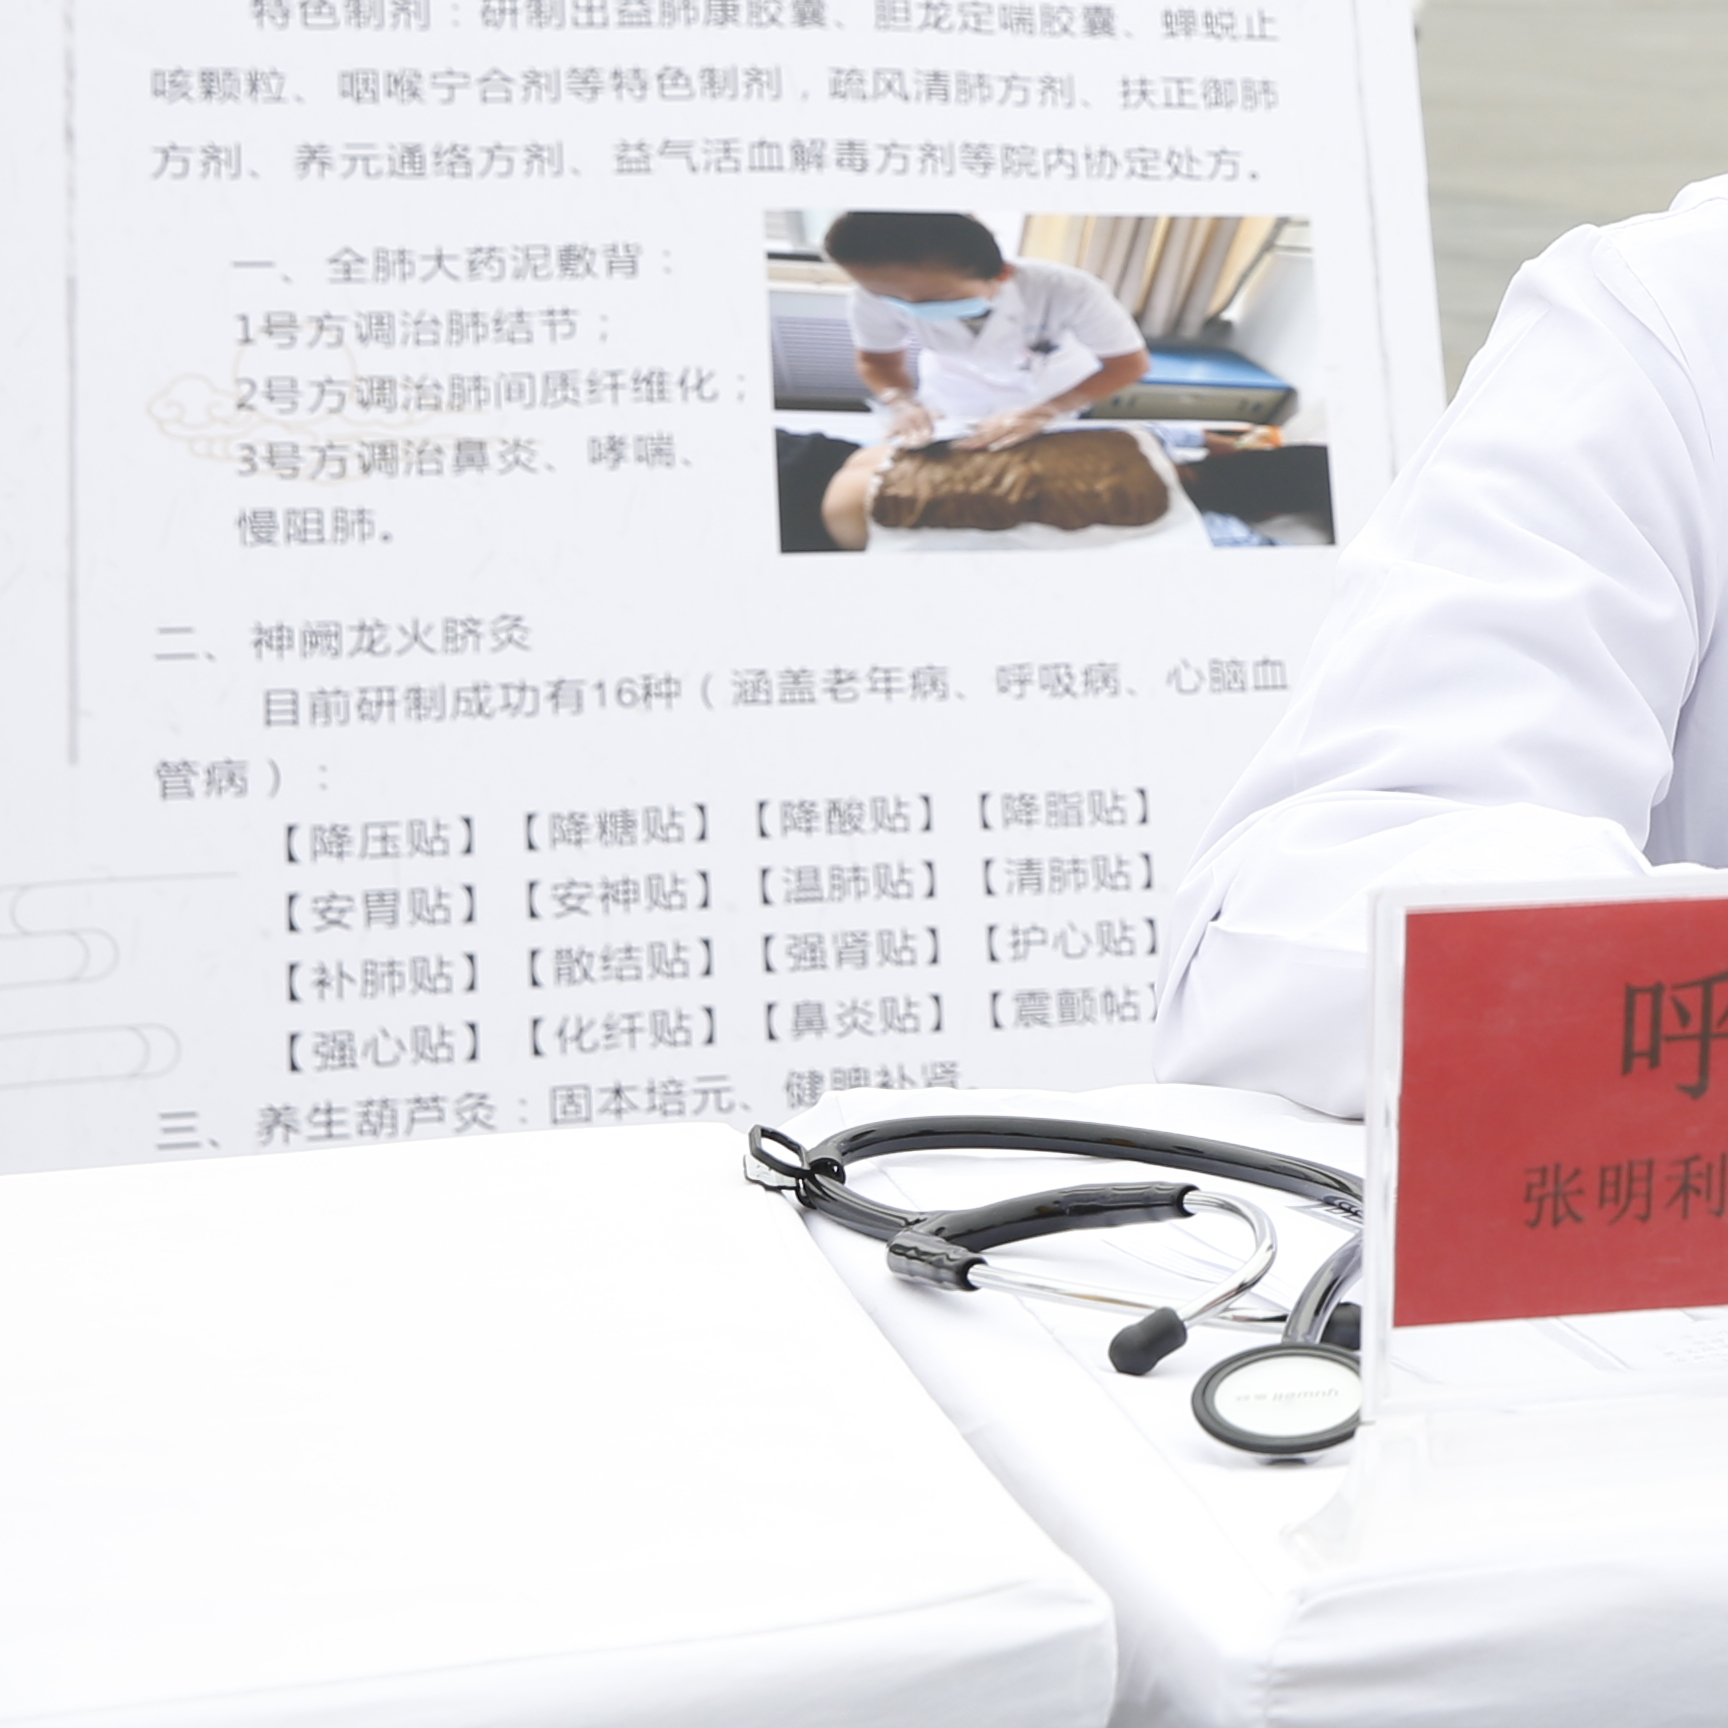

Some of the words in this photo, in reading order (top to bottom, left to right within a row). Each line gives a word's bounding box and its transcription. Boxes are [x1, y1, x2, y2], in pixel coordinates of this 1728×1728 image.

[235, 507, 393, 548] 慢阻肺。
[284, 815, 476, 865] 【降压贴】
[524, 803, 709, 853] 【降糖贴】
[755, 794, 933, 840] 【降酸贴】
[978, 787, 1150, 831] 【降脂贴】
[285, 883, 477, 934] 【安胃贴】
[525, 871, 711, 922] 【安神贴】
[759, 860, 938, 908] 【温肺贴】
[982, 852, 1155, 897] 【清肺贴】
[286, 951, 479, 1004] 【补肺贴】
[528, 938, 714, 989] 【散结贴】
[762, 926, 941, 975] 【强肾贴】
[986, 917, 1158, 965] 【护心贴】
[286, 1021, 480, 1074] 【强心贴】
[529, 1006, 719, 1059] 【化纤贴】
[765, 993, 945, 1043] 【鼻炎贴】
